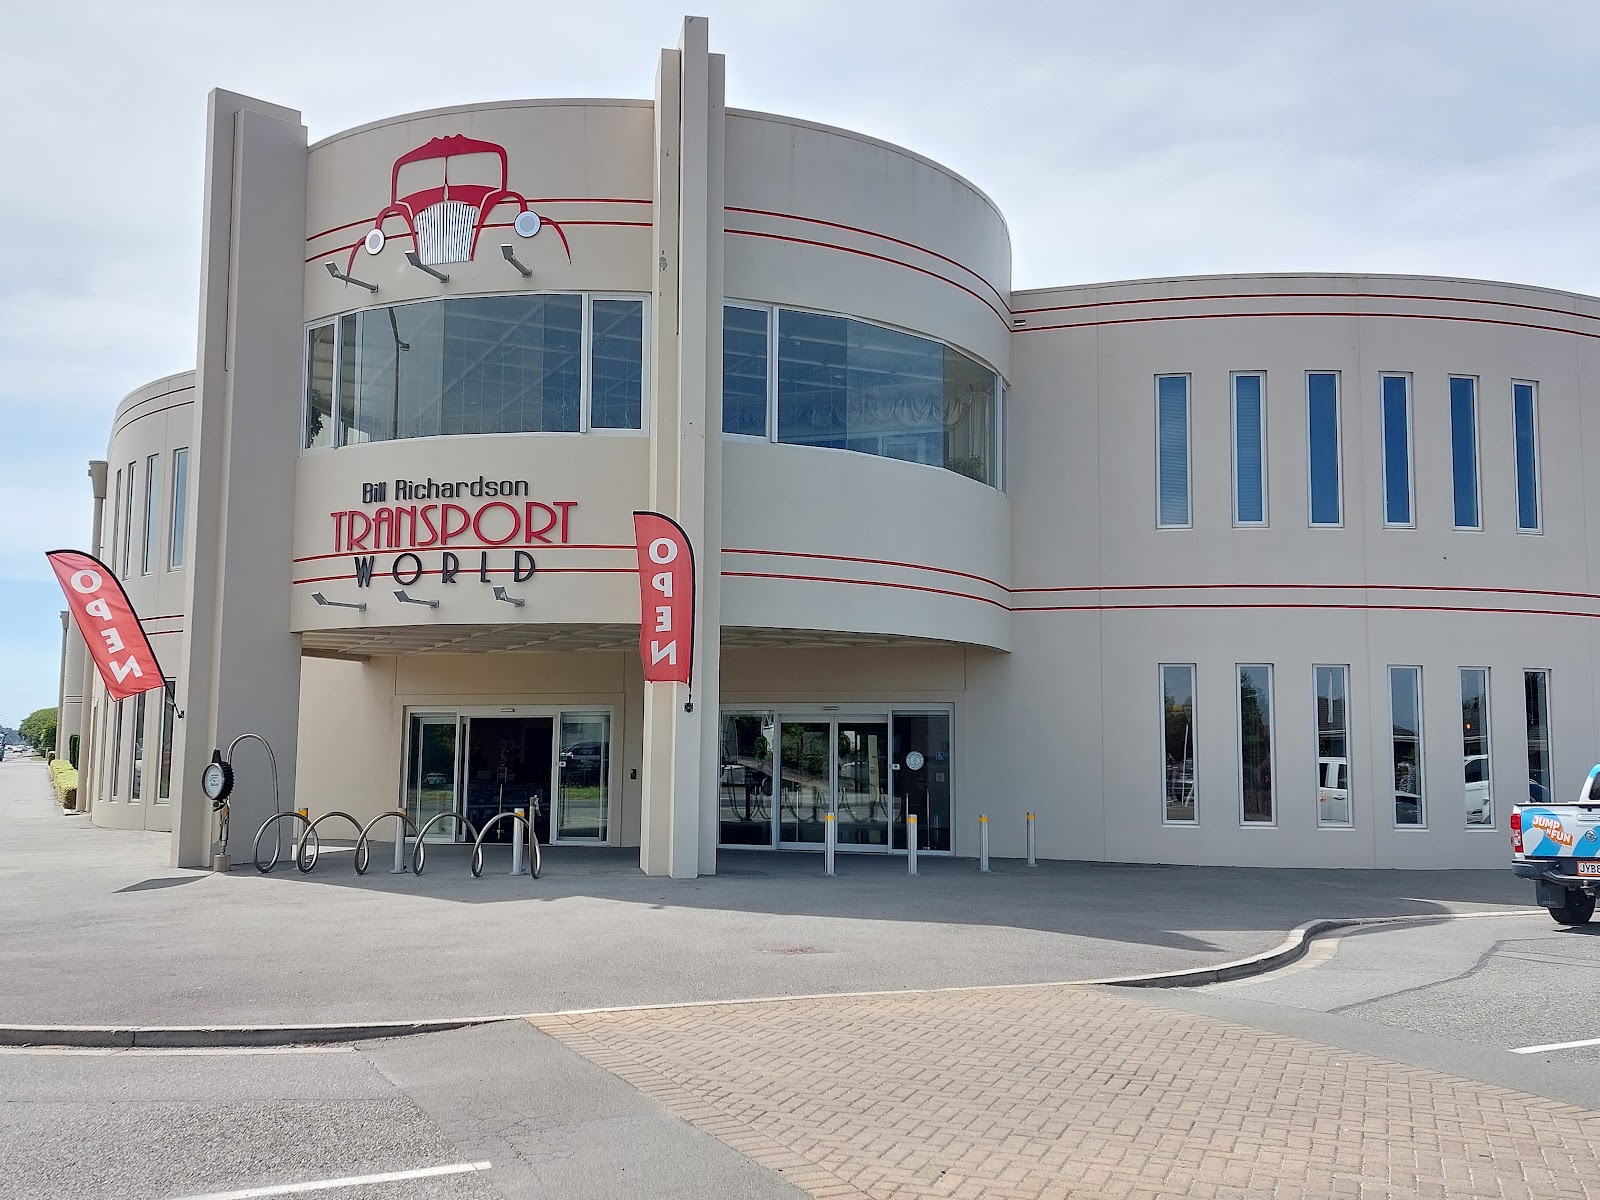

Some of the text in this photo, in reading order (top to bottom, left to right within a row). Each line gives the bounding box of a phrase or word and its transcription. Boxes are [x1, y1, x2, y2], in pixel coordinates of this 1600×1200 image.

[362, 476, 528, 503] Bill Richardson
[330, 502, 577, 552] TRANSPORT
[354, 551, 535, 587] WORLD
[1532, 815, 1561, 830] JUMP
[1550, 829, 1572, 845] FUN
